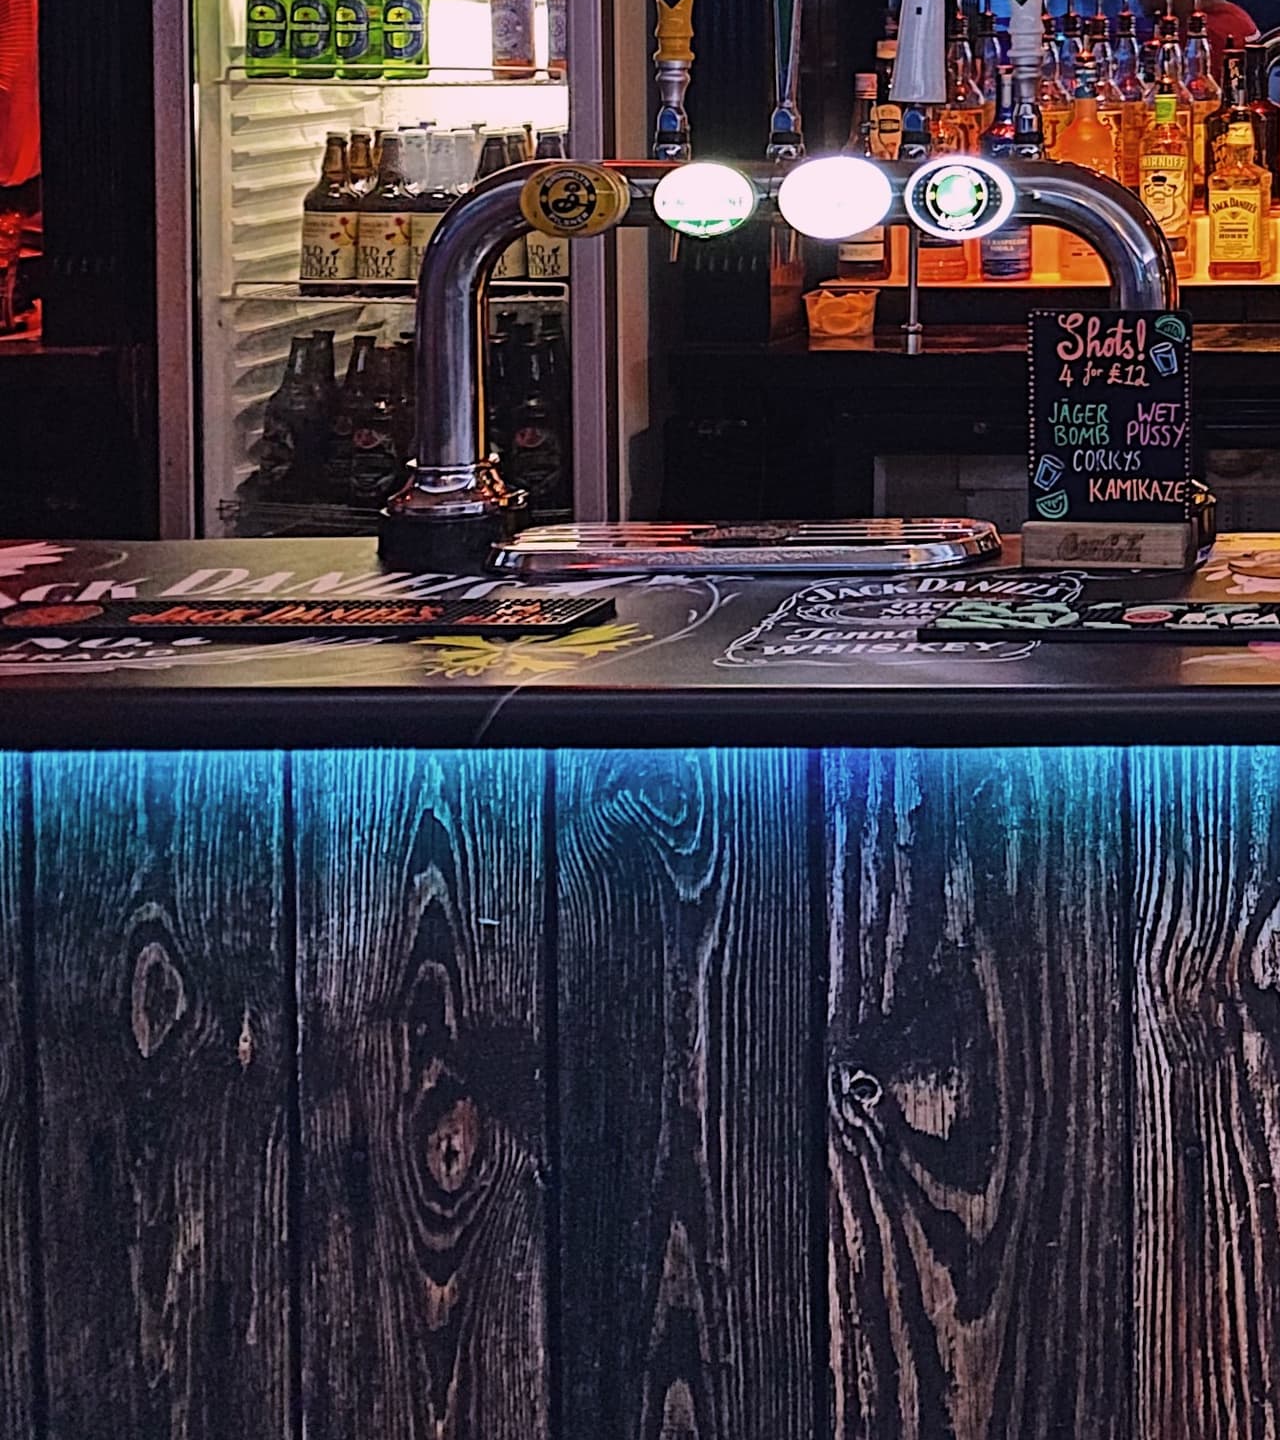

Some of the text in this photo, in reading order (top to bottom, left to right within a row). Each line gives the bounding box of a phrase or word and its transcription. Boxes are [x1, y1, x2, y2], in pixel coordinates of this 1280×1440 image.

[1211, 197, 1257, 215] JACK DANIEL'S
[1056, 312, 1147, 362] Shots!
[1058, 361, 1150, 388] 4 for £12
[1137, 402, 1181, 423] WET
[1054, 424, 1110, 447] BOMB
[1126, 420, 1186, 448] PUSSY
[1073, 449, 1142, 472] CORKYS
[1089, 478, 1185, 503] KAMIKAZE
[810, 578, 1070, 603] JACK DANIEL'S
[128, 605, 263, 625] JACK
[761, 642, 1008, 655] WHISKEY
